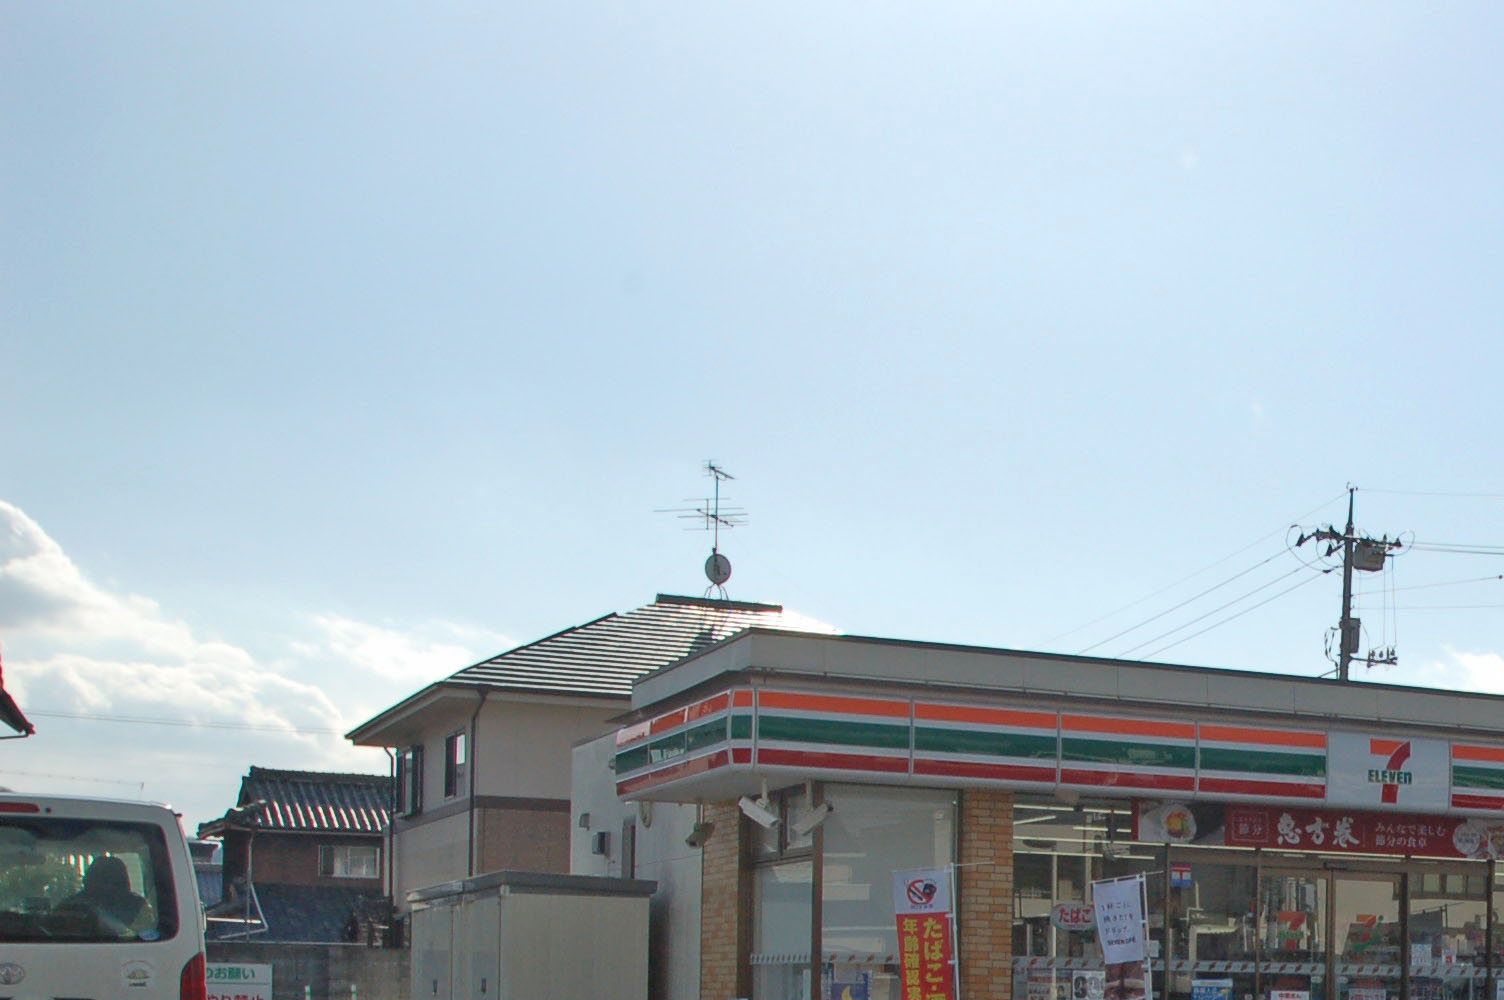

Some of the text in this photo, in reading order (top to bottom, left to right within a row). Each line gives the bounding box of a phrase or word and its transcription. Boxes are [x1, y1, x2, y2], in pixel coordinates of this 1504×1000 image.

[1370, 738, 1411, 803] 7
[1276, 812, 1360, 848] 恵方巻
[1375, 821, 1445, 837] みんなで楽しむ
[1058, 906, 1093, 924] たばこ
